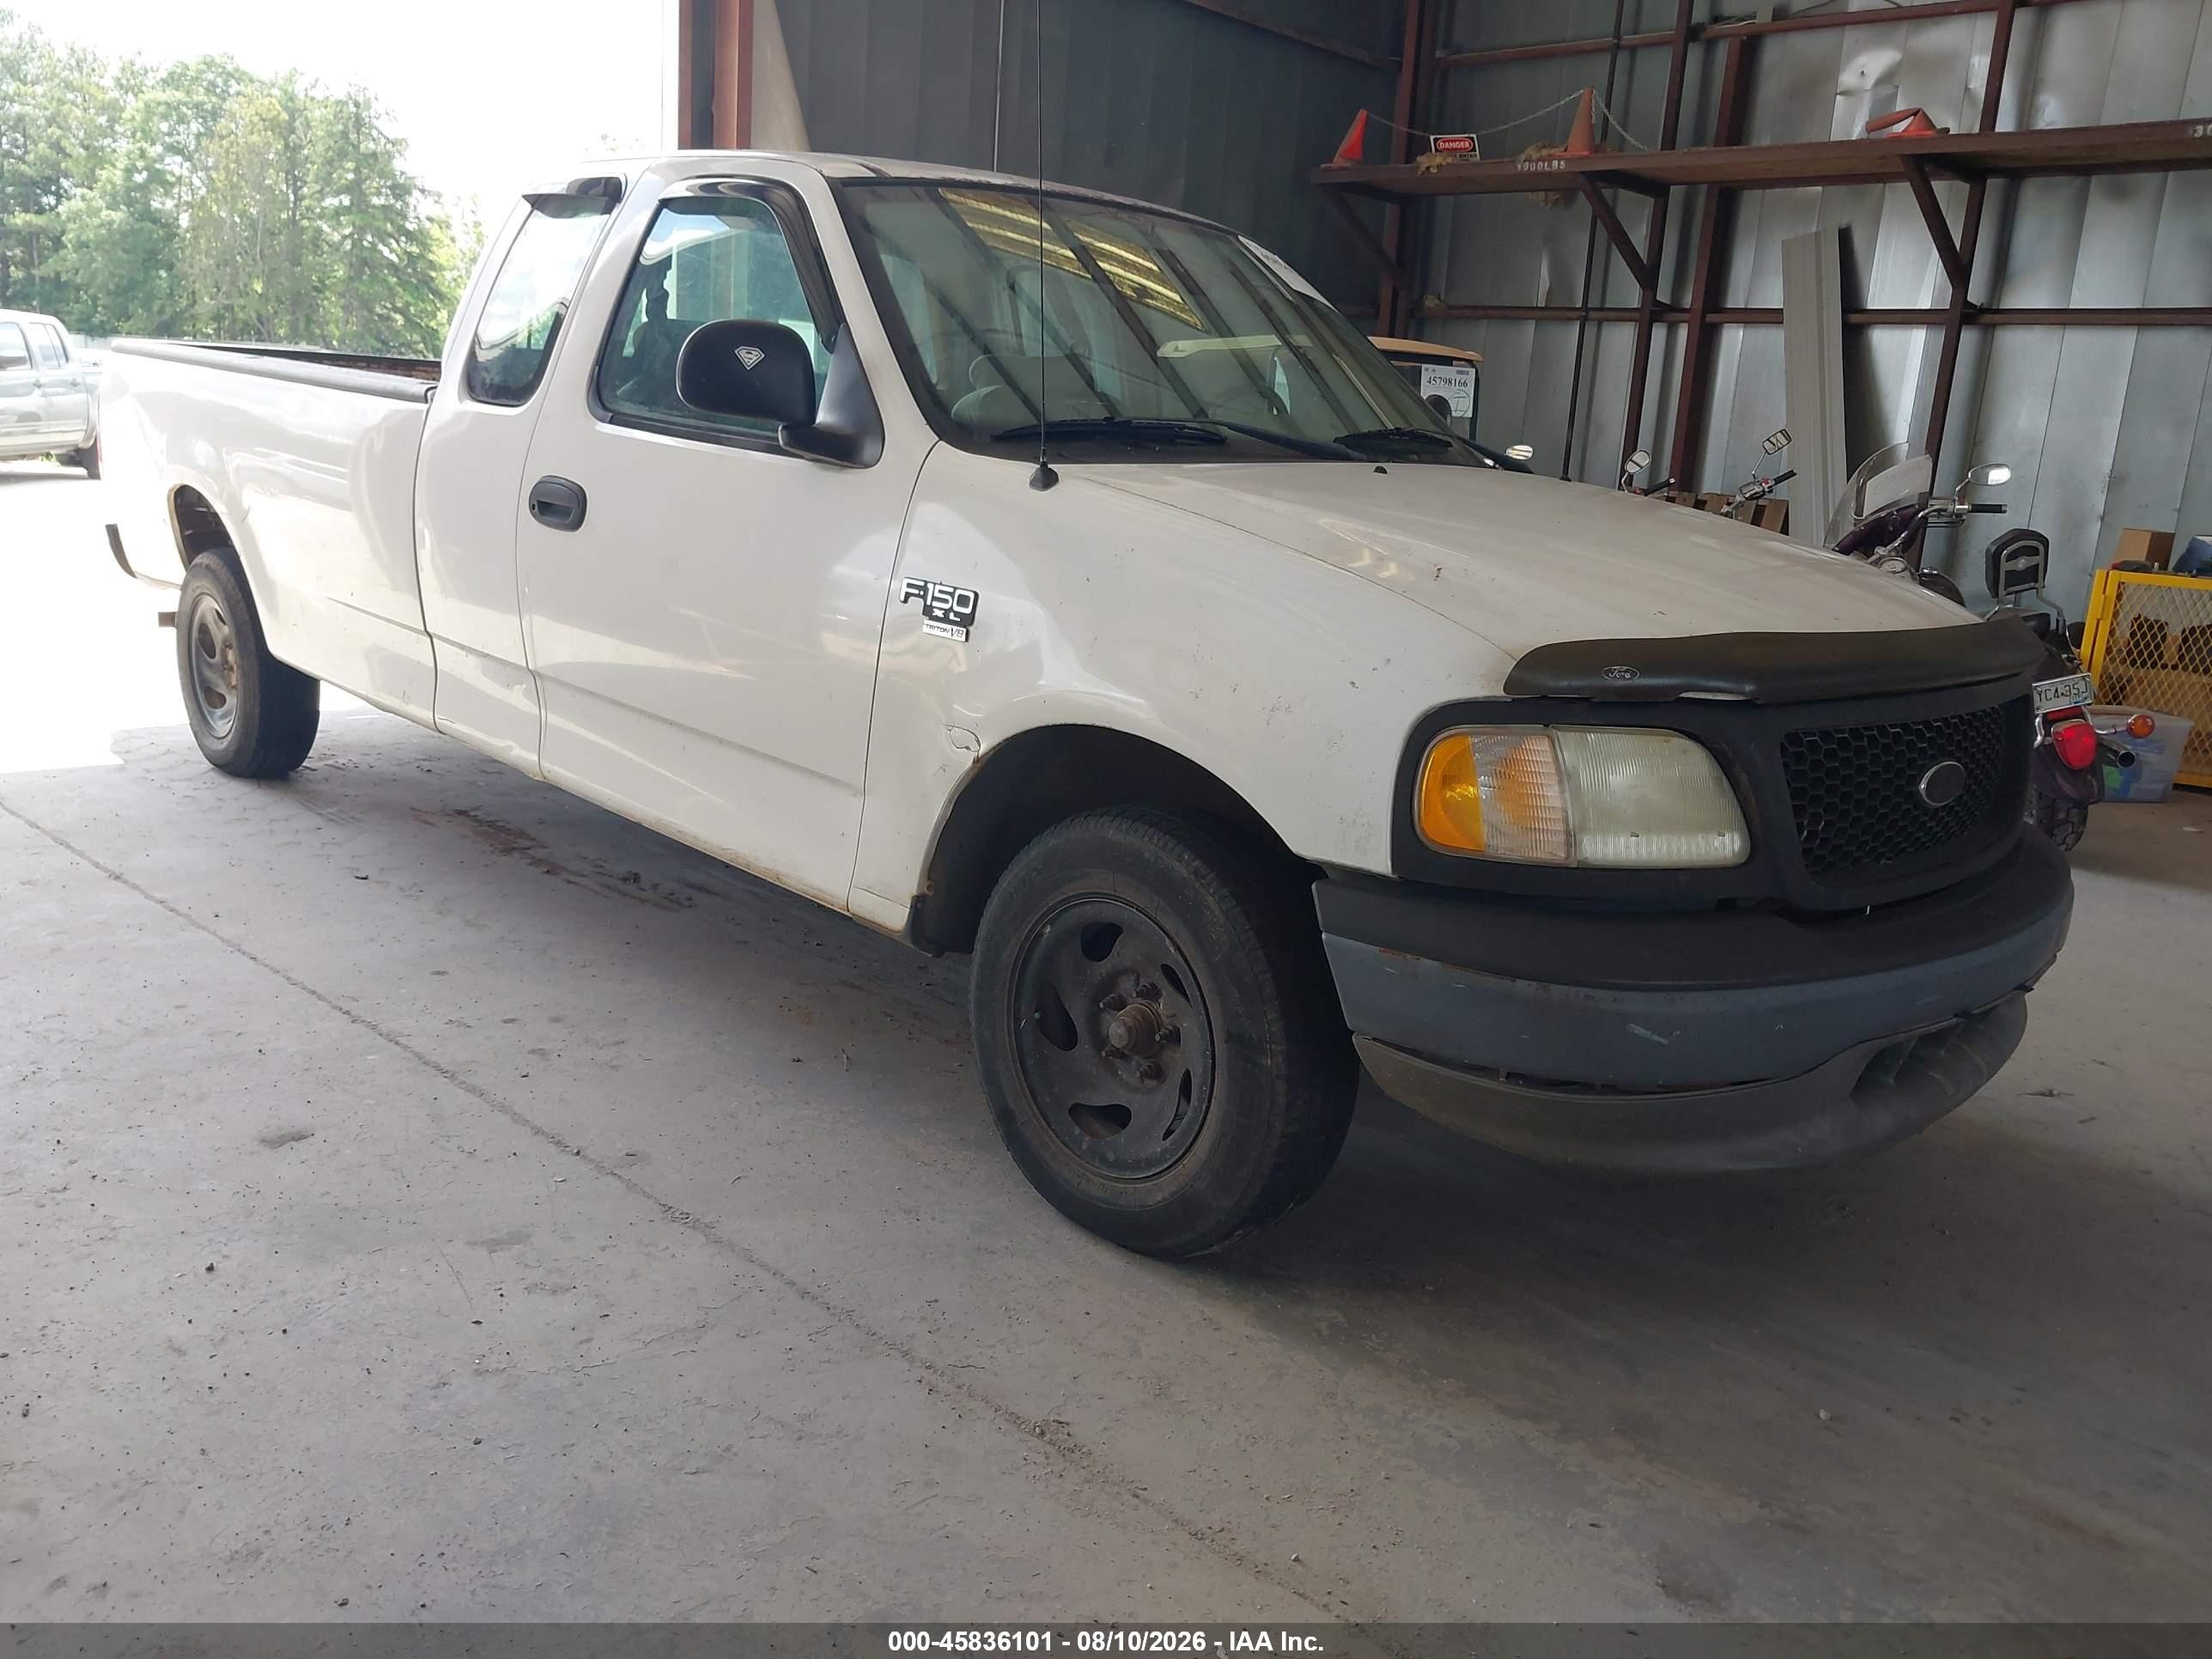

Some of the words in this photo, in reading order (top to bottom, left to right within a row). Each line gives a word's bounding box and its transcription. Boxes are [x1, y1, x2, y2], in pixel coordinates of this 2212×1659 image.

[1439, 141, 1470, 149] DANGER
[1426, 376, 1468, 387] 45798166
[932, 608, 961, 622] XL
[926, 623, 950, 634] TRITON
[950, 627, 964, 638] V8
